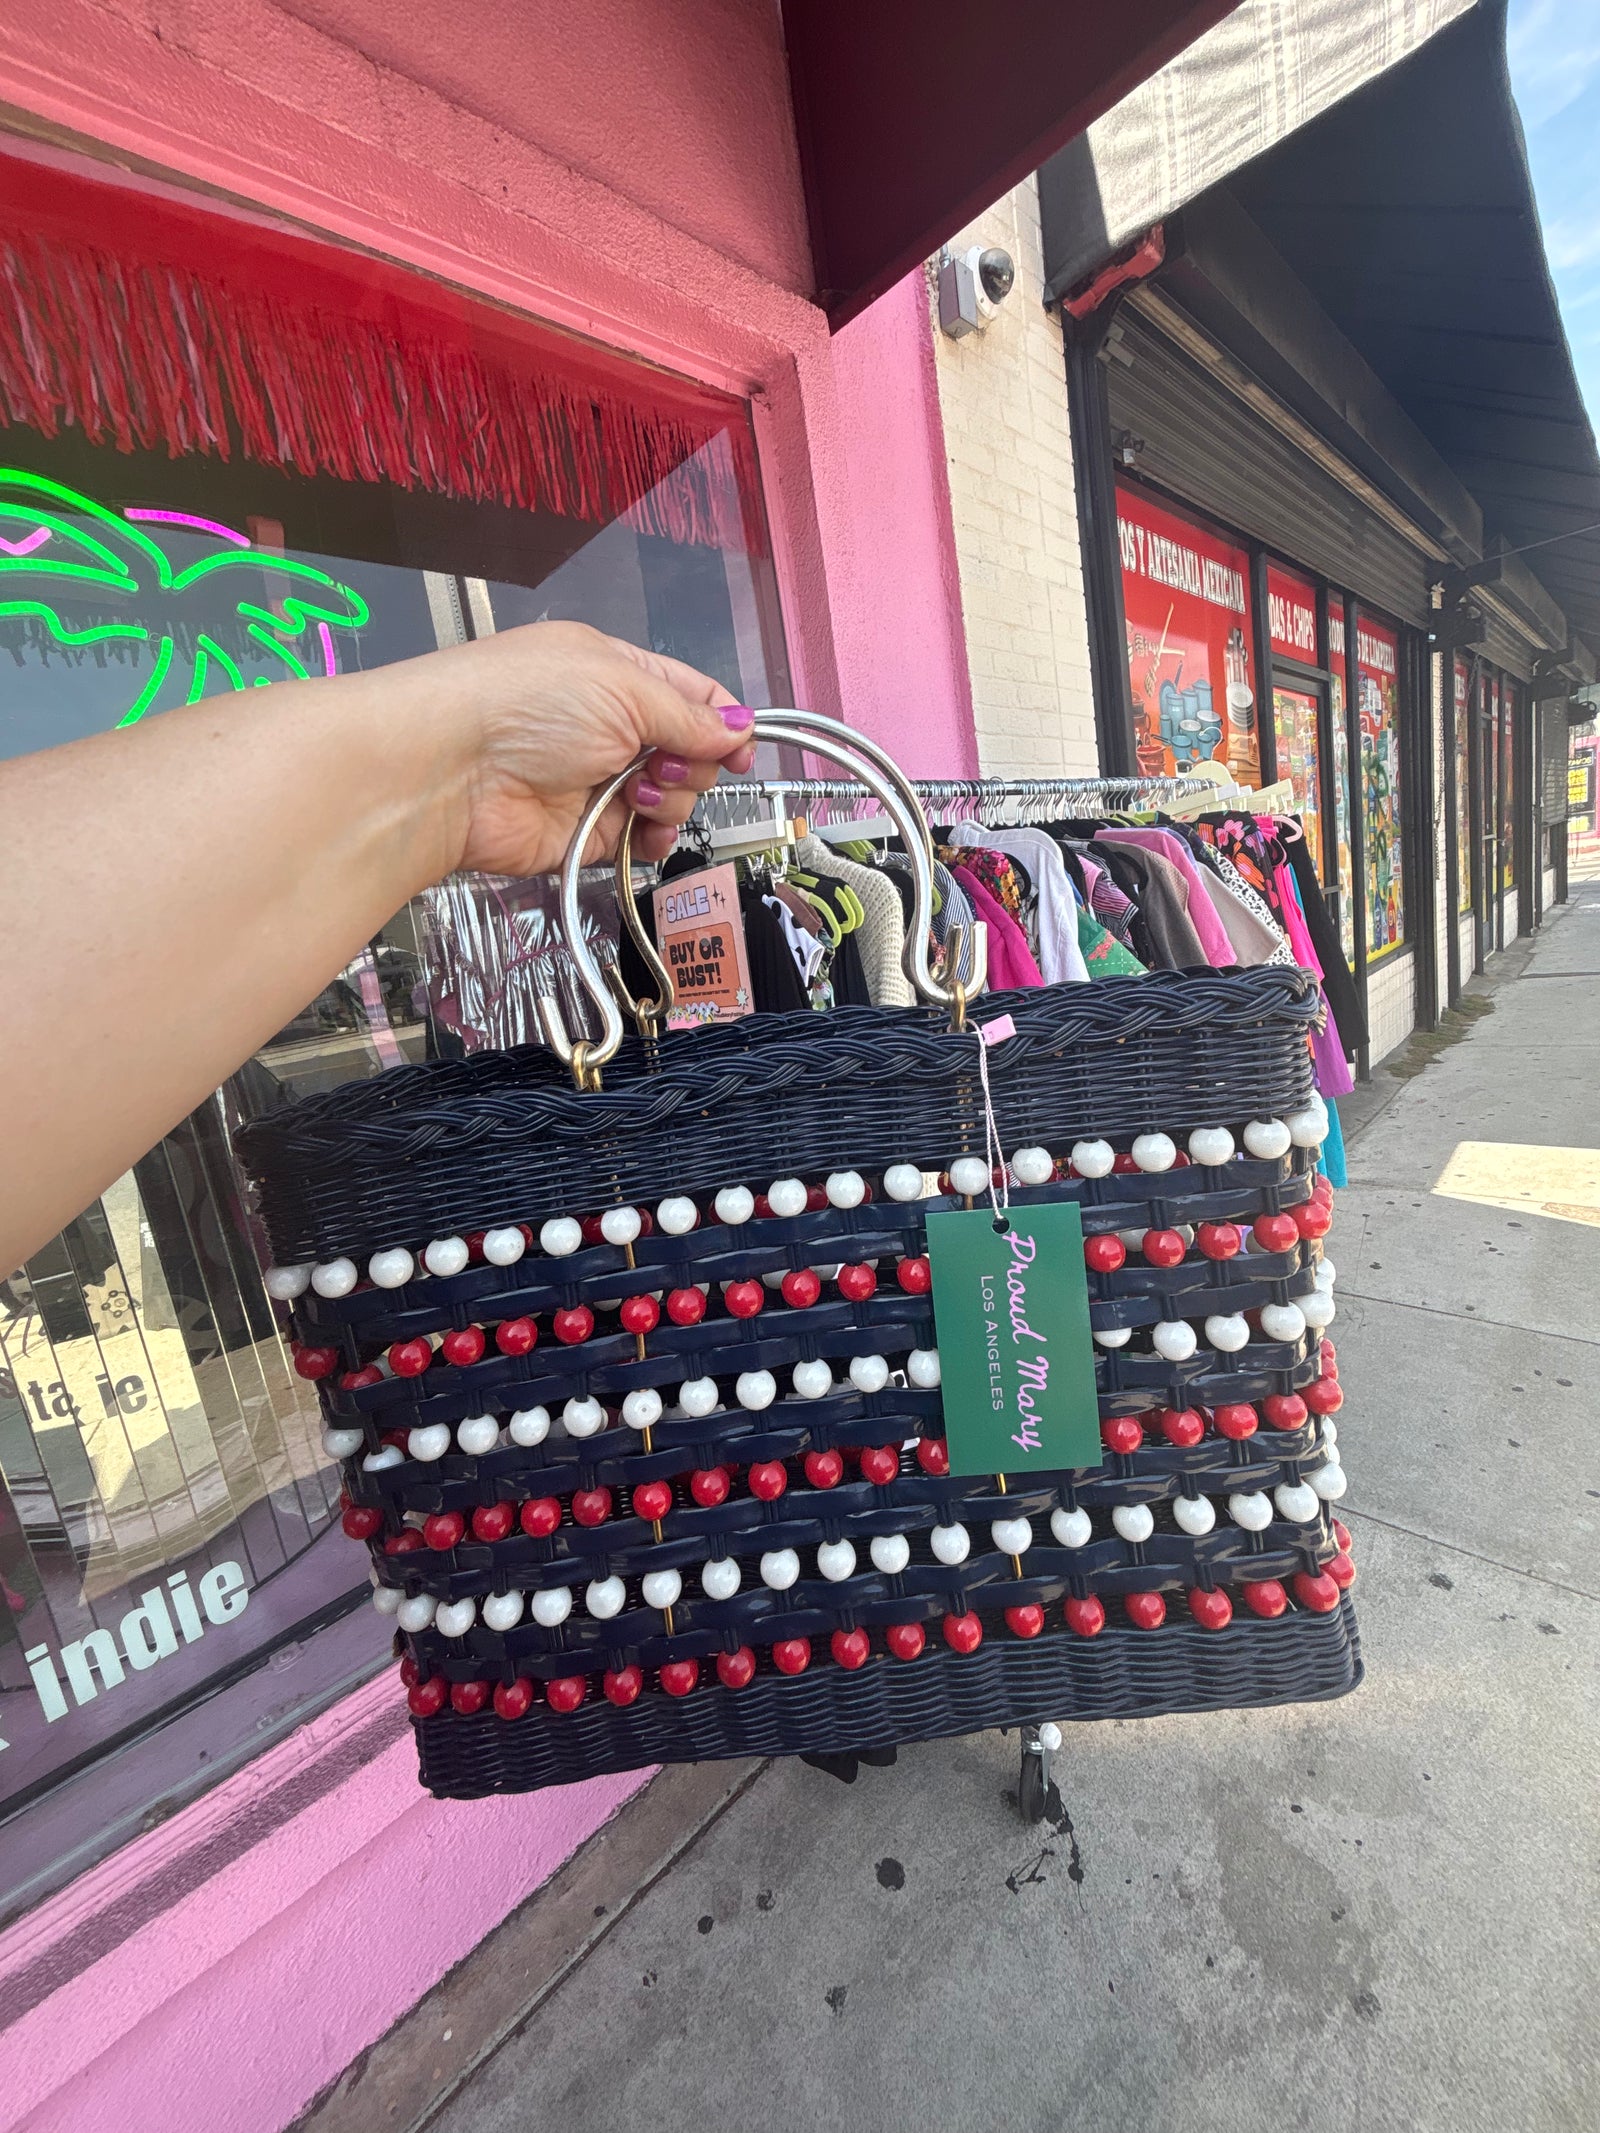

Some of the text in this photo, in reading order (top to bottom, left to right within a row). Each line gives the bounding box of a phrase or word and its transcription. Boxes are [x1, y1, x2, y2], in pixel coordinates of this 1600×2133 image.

[1117, 516, 1136, 573] OS
[1135, 524, 1145, 577] Y
[1201, 555, 1246, 615] MEXICANA
[1268, 592, 1315, 652] DAS & CHIPS
[666, 885, 710, 923] SALE
[669, 935, 725, 965] BUY OR
[676, 962, 722, 988] BUST!
[980, 1275, 1004, 1411] LOS ANGELES
[1002, 1231, 1050, 1453] Proud Mary
[25, 1561, 249, 1723] indie
